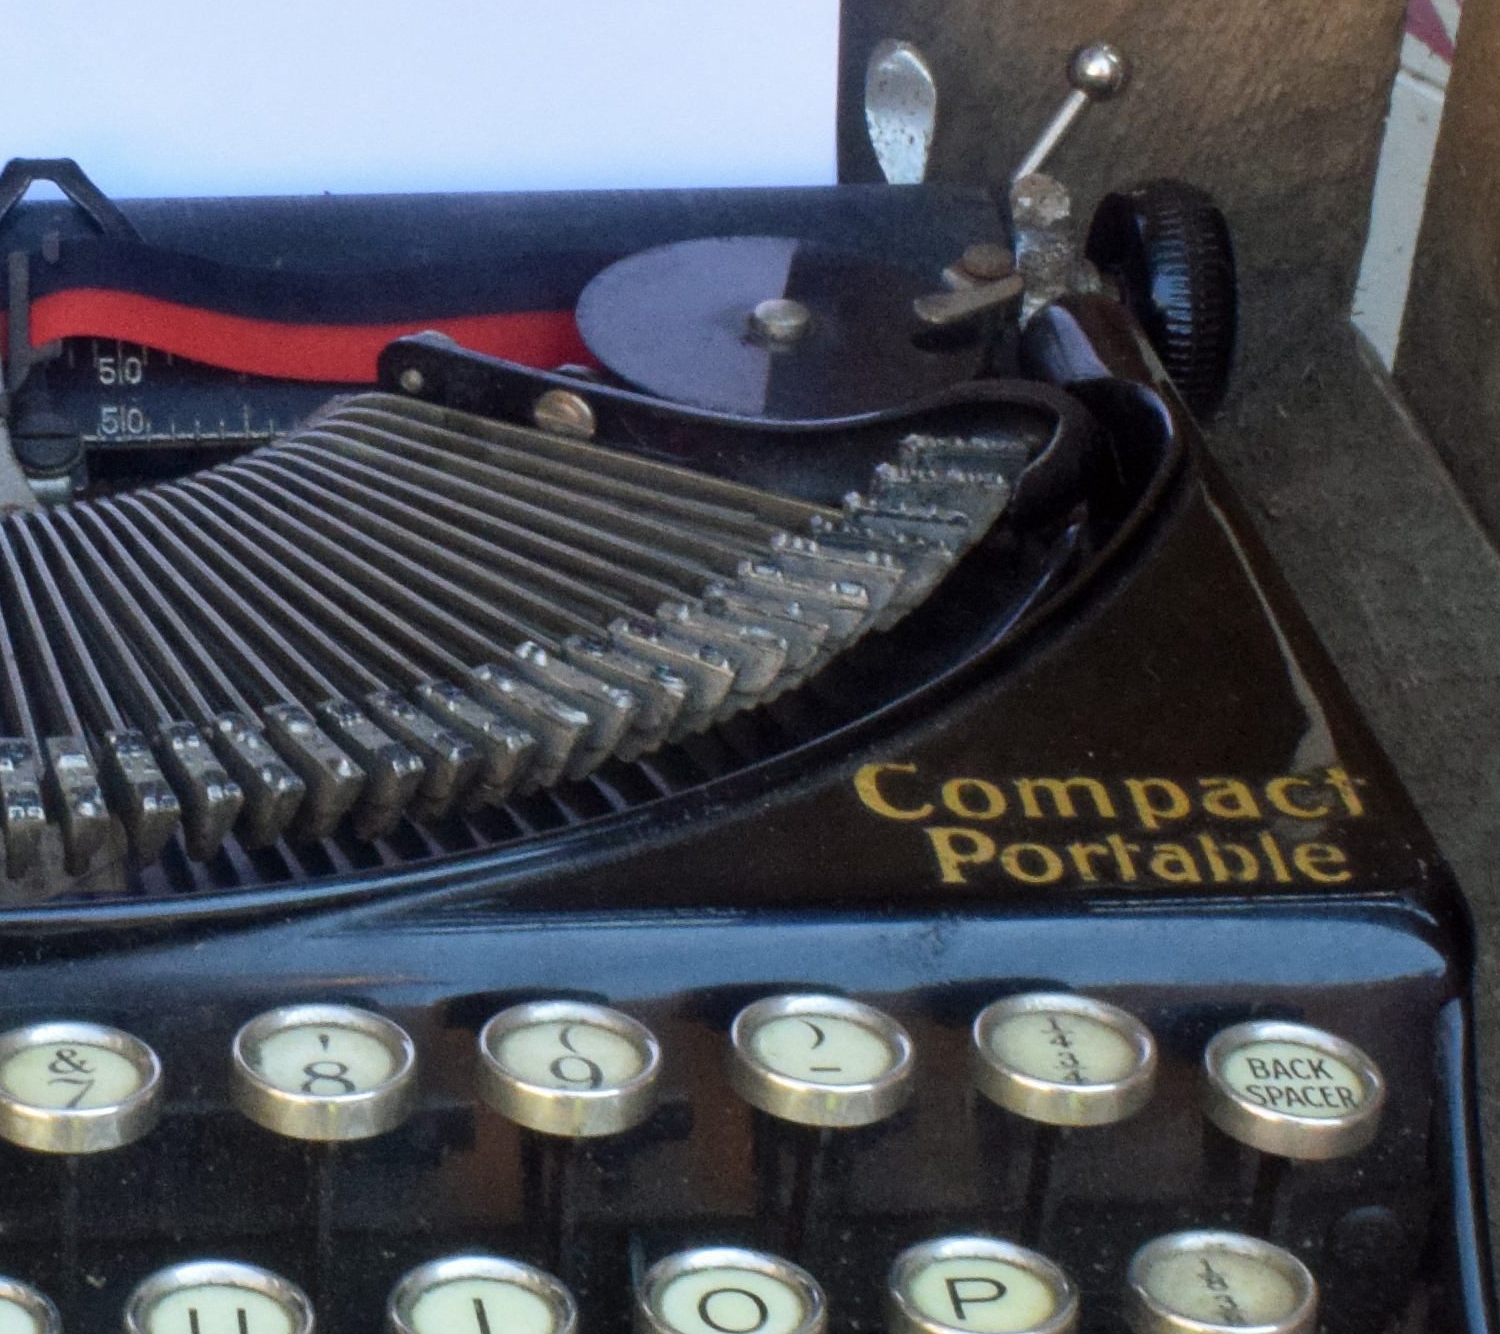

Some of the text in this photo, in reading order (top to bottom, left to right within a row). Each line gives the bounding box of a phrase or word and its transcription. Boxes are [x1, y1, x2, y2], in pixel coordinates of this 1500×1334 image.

[854, 763, 1367, 830] Compact
[924, 825, 1353, 885] Portable
[302, 1061, 356, 1093] 8
[550, 1055, 604, 1089] 9
[1246, 1057, 1333, 1080] BACK
[1245, 1084, 1359, 1109] SPACER
[699, 1287, 769, 1334] O
[945, 1277, 1007, 1321] P
